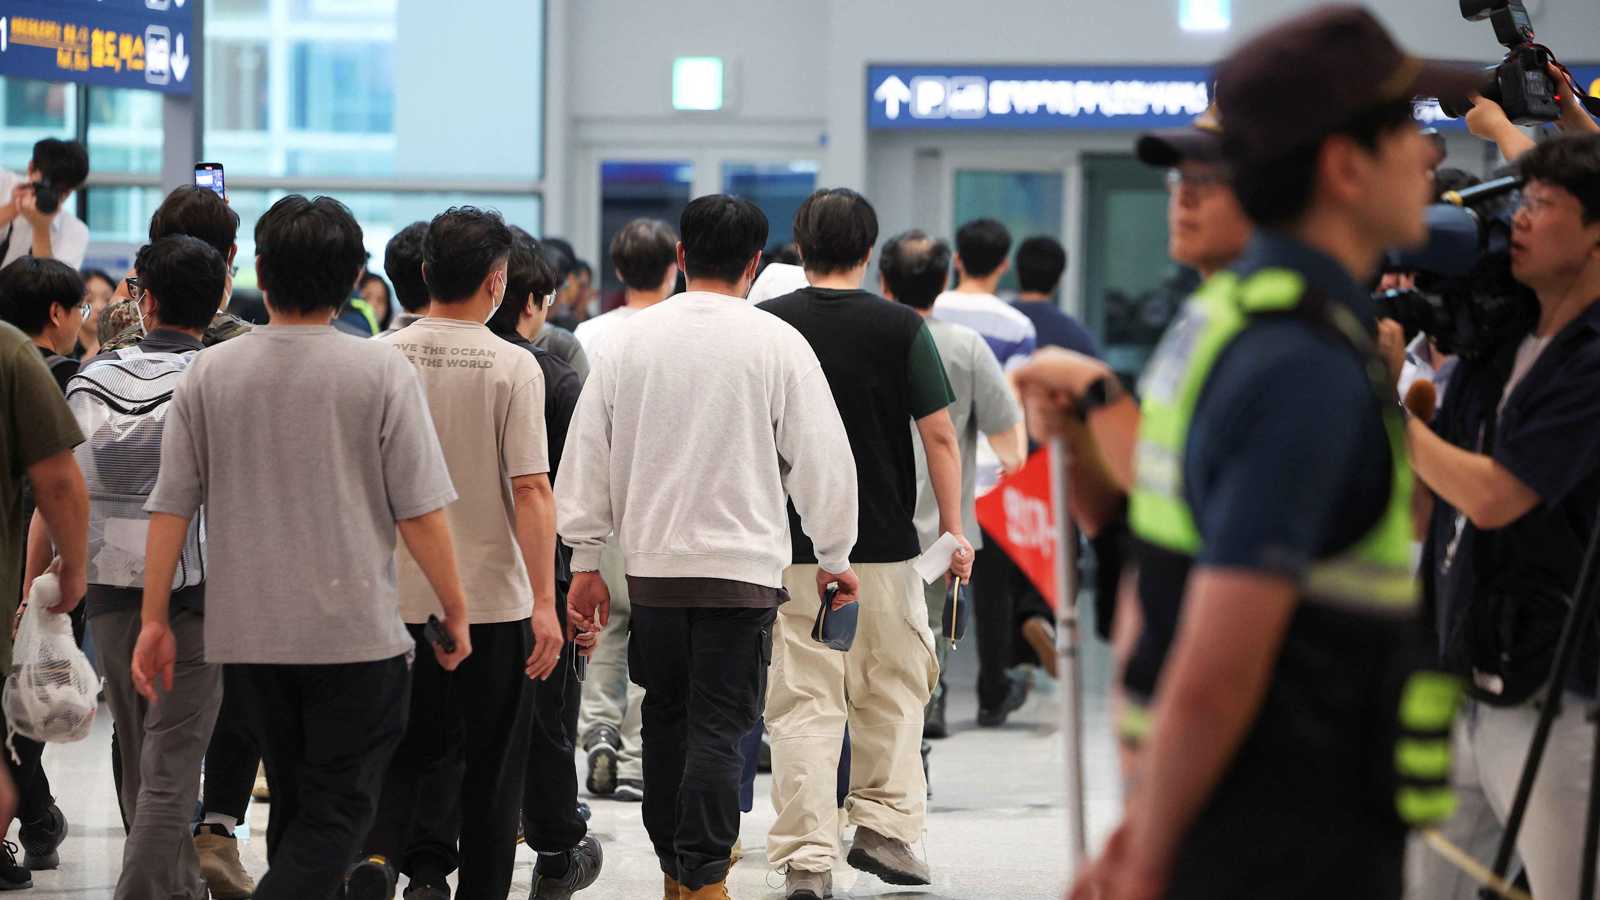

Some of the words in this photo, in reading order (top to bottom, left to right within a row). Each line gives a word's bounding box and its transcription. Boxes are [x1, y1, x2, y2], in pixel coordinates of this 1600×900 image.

[422, 345, 447, 355] THE
[450, 347, 497, 358] OCEAN
[419, 356, 443, 367] THE
[447, 360, 494, 368] WORLD
